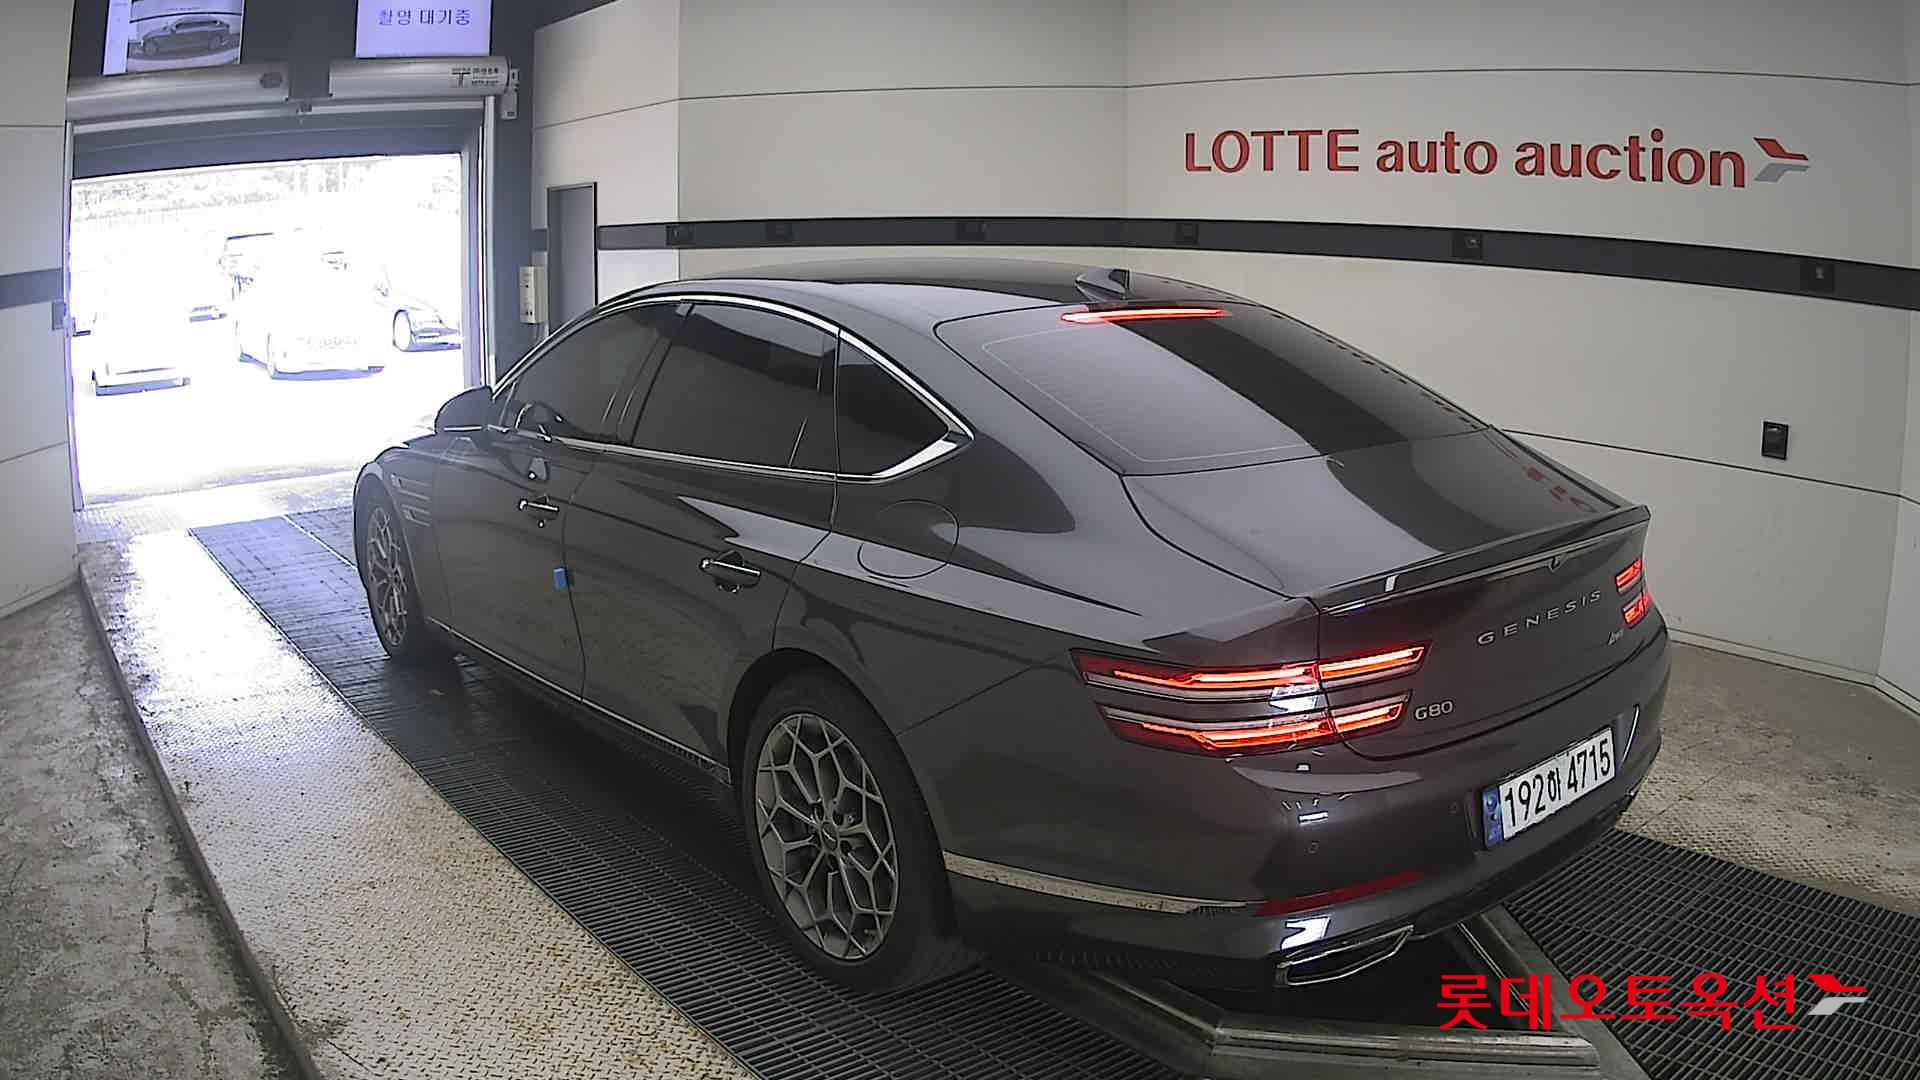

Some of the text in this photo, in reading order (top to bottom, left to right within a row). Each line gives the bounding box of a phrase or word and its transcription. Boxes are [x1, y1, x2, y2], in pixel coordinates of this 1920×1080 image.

[420, 8, 471, 26] 대기중
[1184, 129, 1746, 188] LOTTE auto auction
[1477, 590, 1601, 645] GENESIS
[1415, 701, 1453, 720] G80
[1567, 738, 1611, 793] 4715
